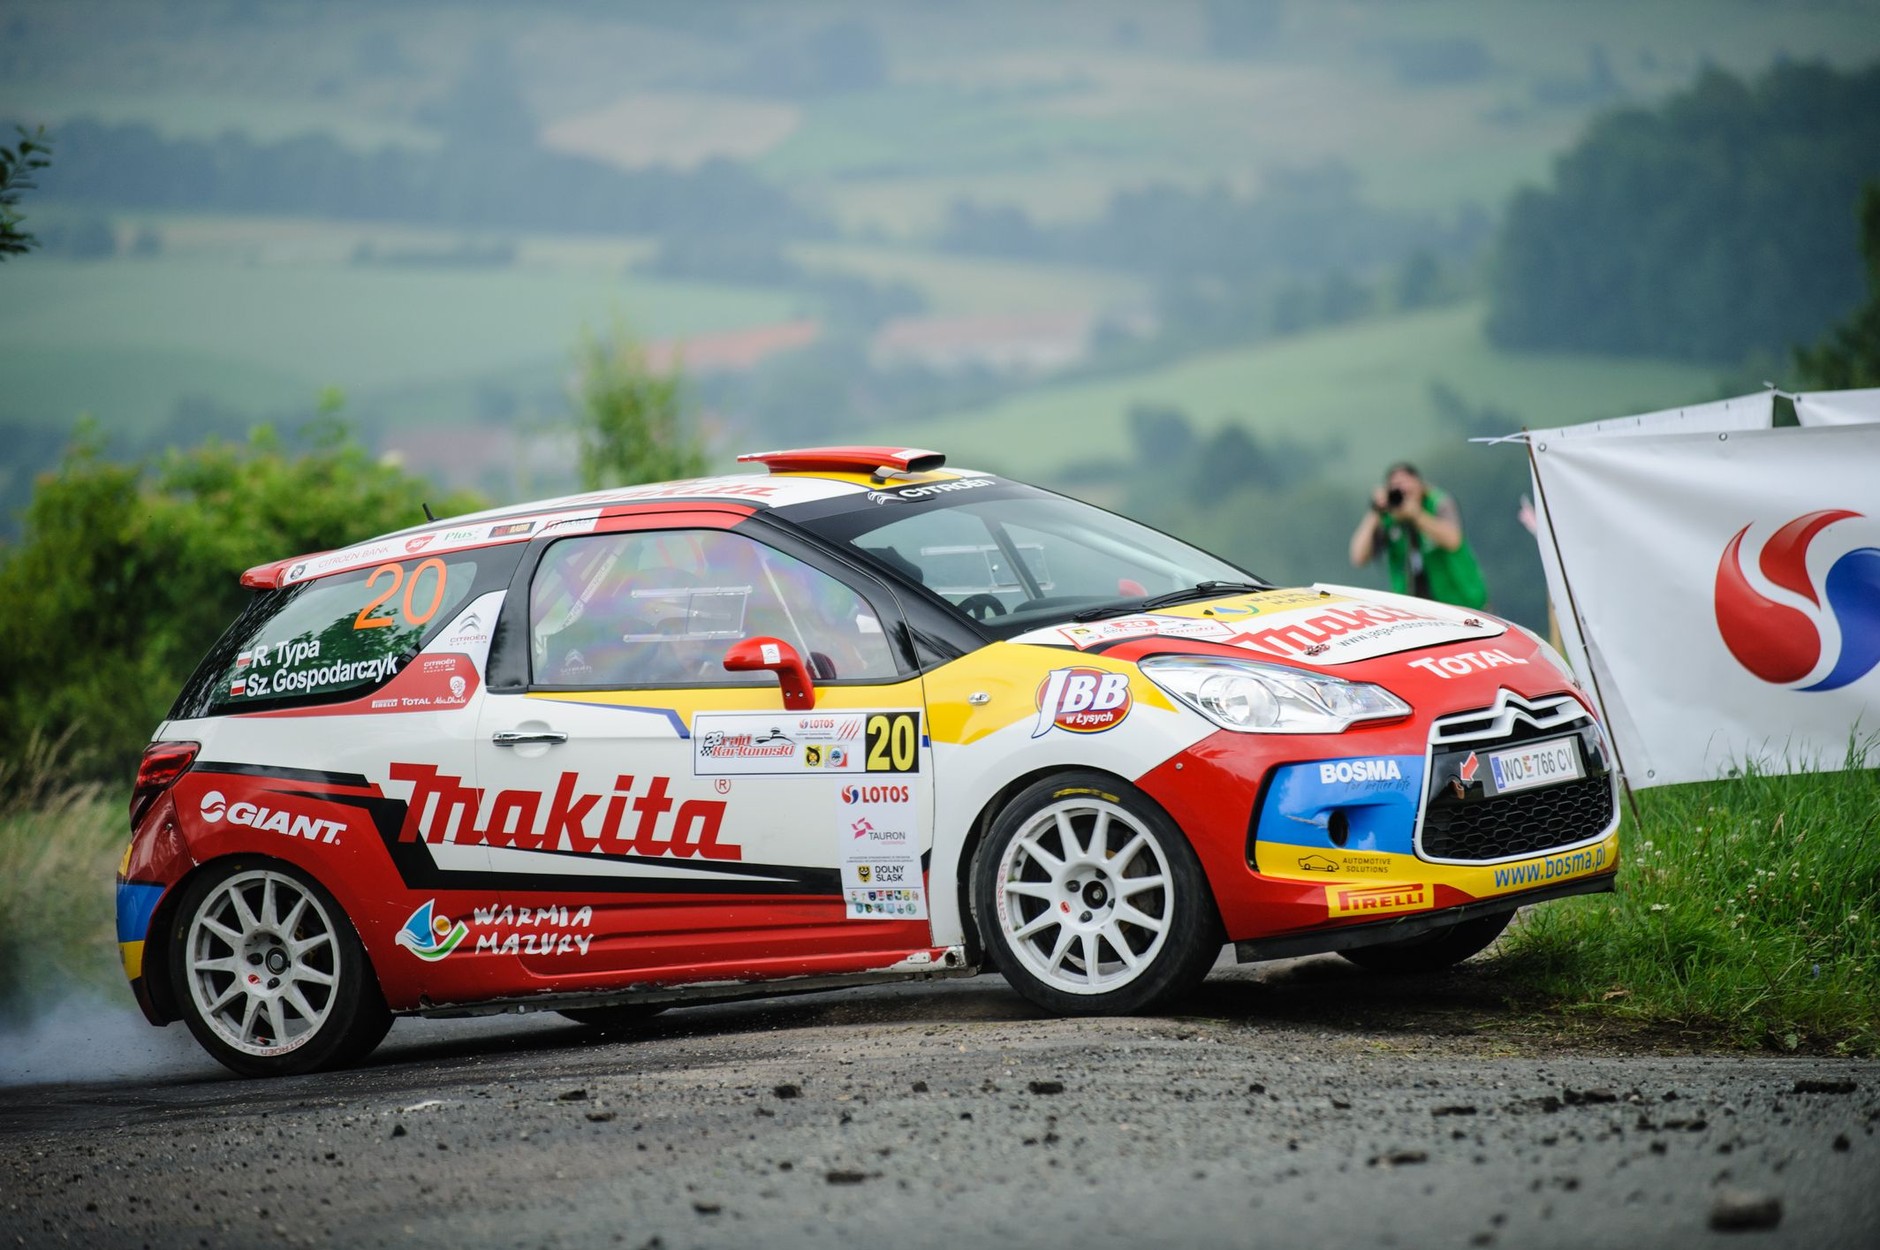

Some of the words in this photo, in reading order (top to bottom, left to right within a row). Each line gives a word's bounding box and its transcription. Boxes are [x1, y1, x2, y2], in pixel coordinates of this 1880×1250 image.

[353, 558, 447, 630] 20
[252, 645, 271, 668] R.
[275, 640, 320, 668] Typa
[1408, 649, 1529, 678] TOTAL
[246, 673, 271, 697] Sz.
[273, 652, 399, 693] Gospodarczyk
[401, 697, 430, 706] TOTAL
[1032, 669, 1130, 739] JBB
[810, 719, 834, 728] LOTOS
[1066, 716, 1075, 724] w
[1076, 711, 1114, 726] Łysych
[703, 731, 724, 747] 28
[866, 714, 915, 771] 20
[1320, 760, 1401, 784] BOSMA
[1501, 757, 1523, 782] WO
[1532, 752, 1556, 776] 766
[1557, 747, 1573, 771] CV
[862, 785, 909, 803] LOTOS
[227, 802, 347, 844] GIANT
[389, 762, 742, 861] makita
[868, 832, 905, 840] TAURON
[875, 865, 904, 874] DOLNY
[1342, 857, 1391, 865] AUTOMOTIVE
[1494, 842, 1605, 888] www.bosma.pl
[1338, 883, 1423, 911] PIRELLI
[474, 903, 593, 927] WARMIA
[475, 931, 594, 955] MAZURY
